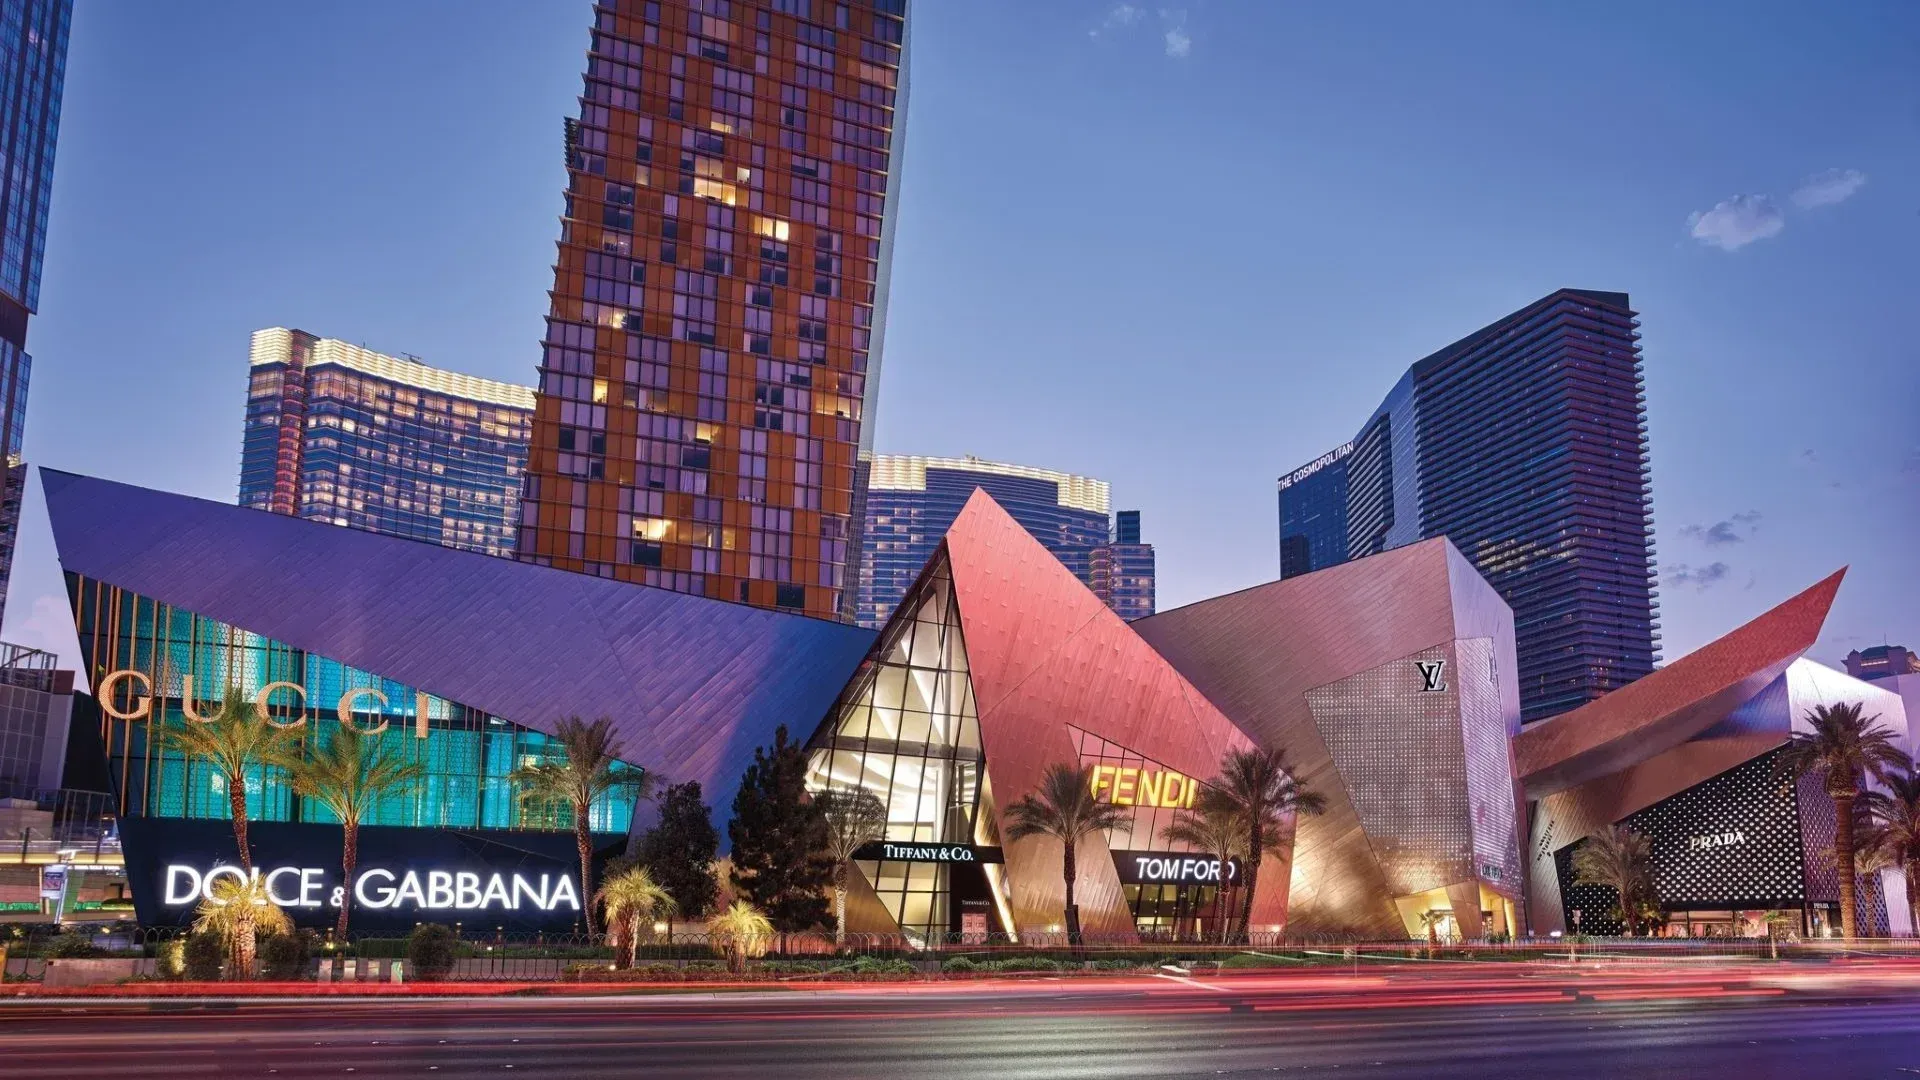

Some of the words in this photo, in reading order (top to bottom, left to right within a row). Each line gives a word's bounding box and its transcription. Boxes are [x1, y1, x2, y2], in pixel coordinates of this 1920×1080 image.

[1277, 476, 1292, 491] THE
[1293, 441, 1354, 483] COSMOPOLITAN
[98, 669, 429, 739] GUCCI
[1091, 764, 1198, 810] FENDI
[1689, 831, 1746, 851] PRADA
[164, 864, 325, 907] DOLCE
[329, 886, 345, 907] &
[354, 868, 581, 910] GABBANA
[1135, 857, 1181, 880] TOM
